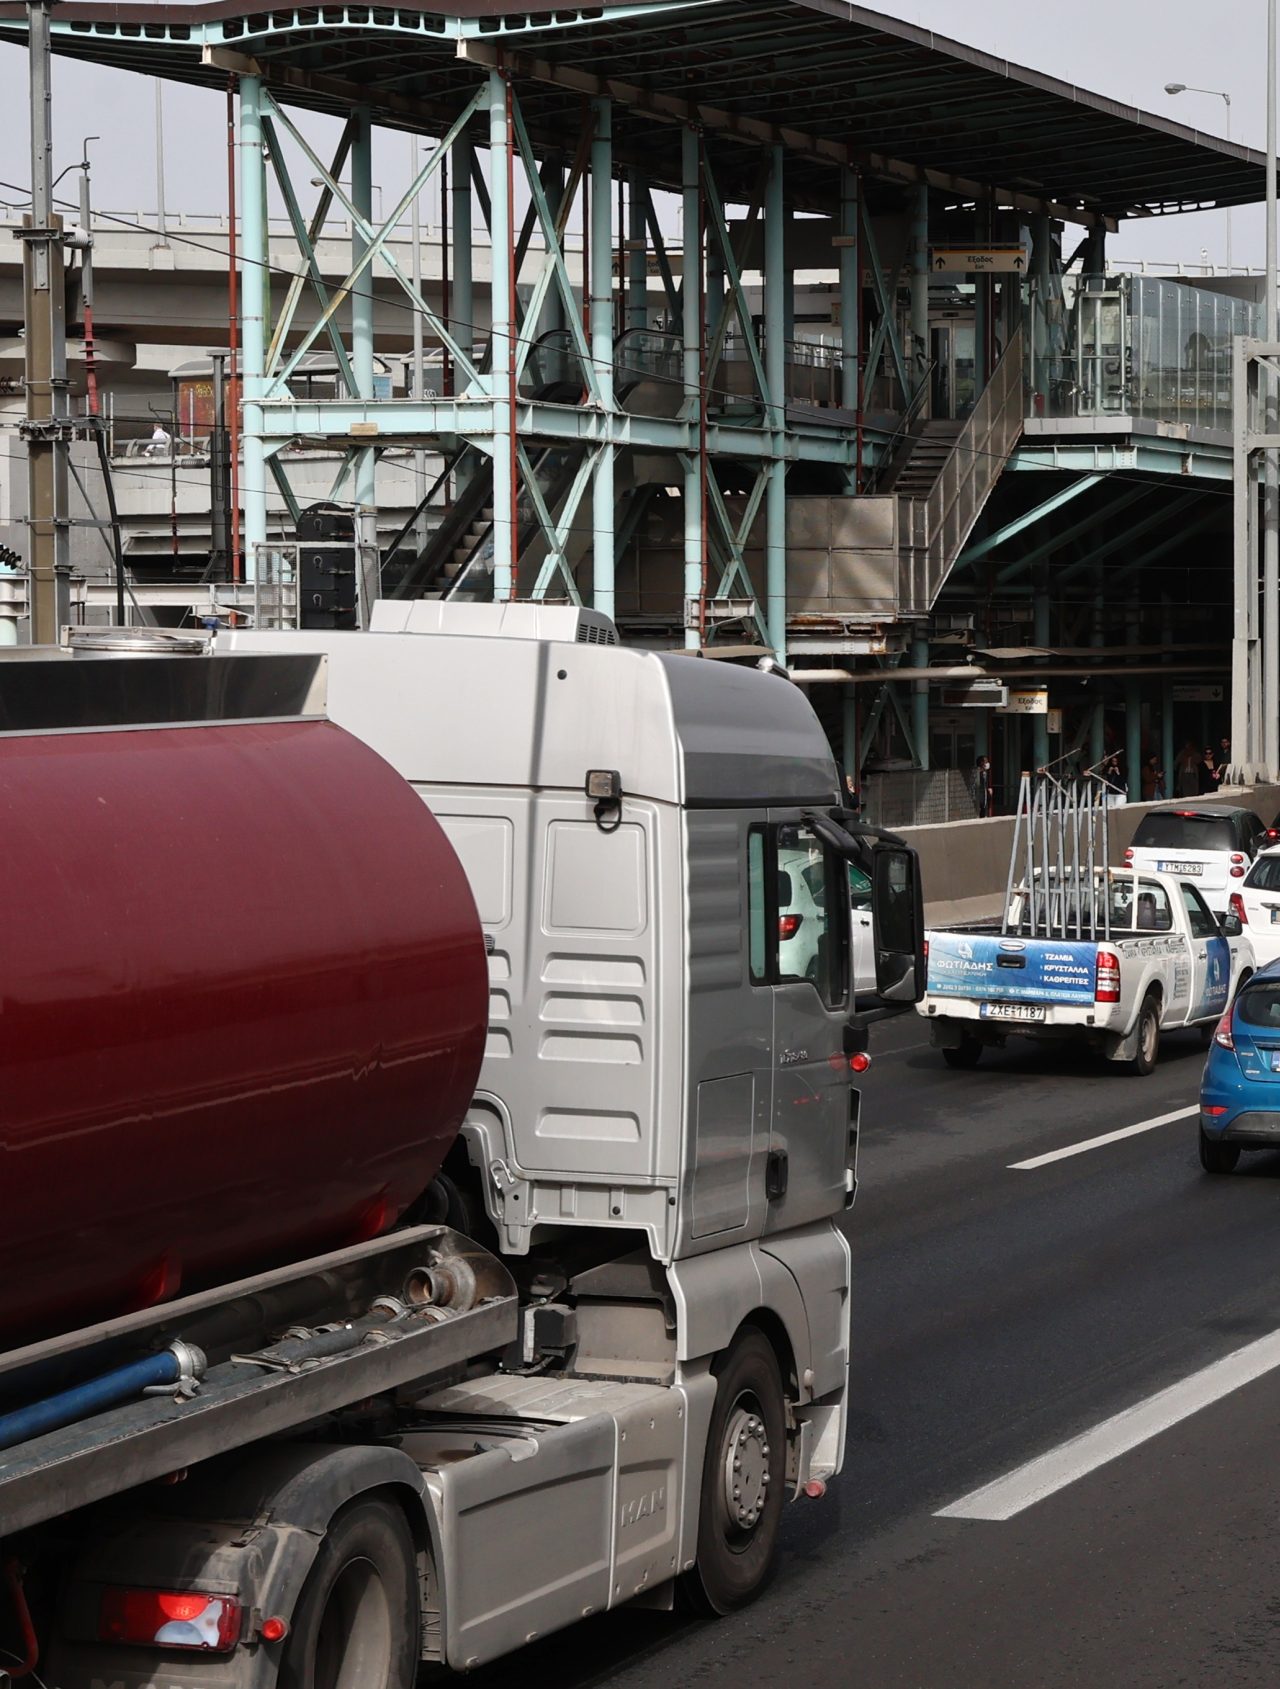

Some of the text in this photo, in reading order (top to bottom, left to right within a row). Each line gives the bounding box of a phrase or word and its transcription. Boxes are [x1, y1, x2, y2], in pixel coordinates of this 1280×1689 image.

[1044, 953, 1073, 962] ΤΖΑΜΙΑ
[936, 960, 993, 971] ΦΩΤΙΑΔΗΣ
[1043, 965, 1089, 974] ΚΡΥΣΤΑΛΛΑ
[1043, 975, 1089, 985] ΚΑΘΡΕΠΤΕΣ
[621, 1486, 665, 1528] MAN
